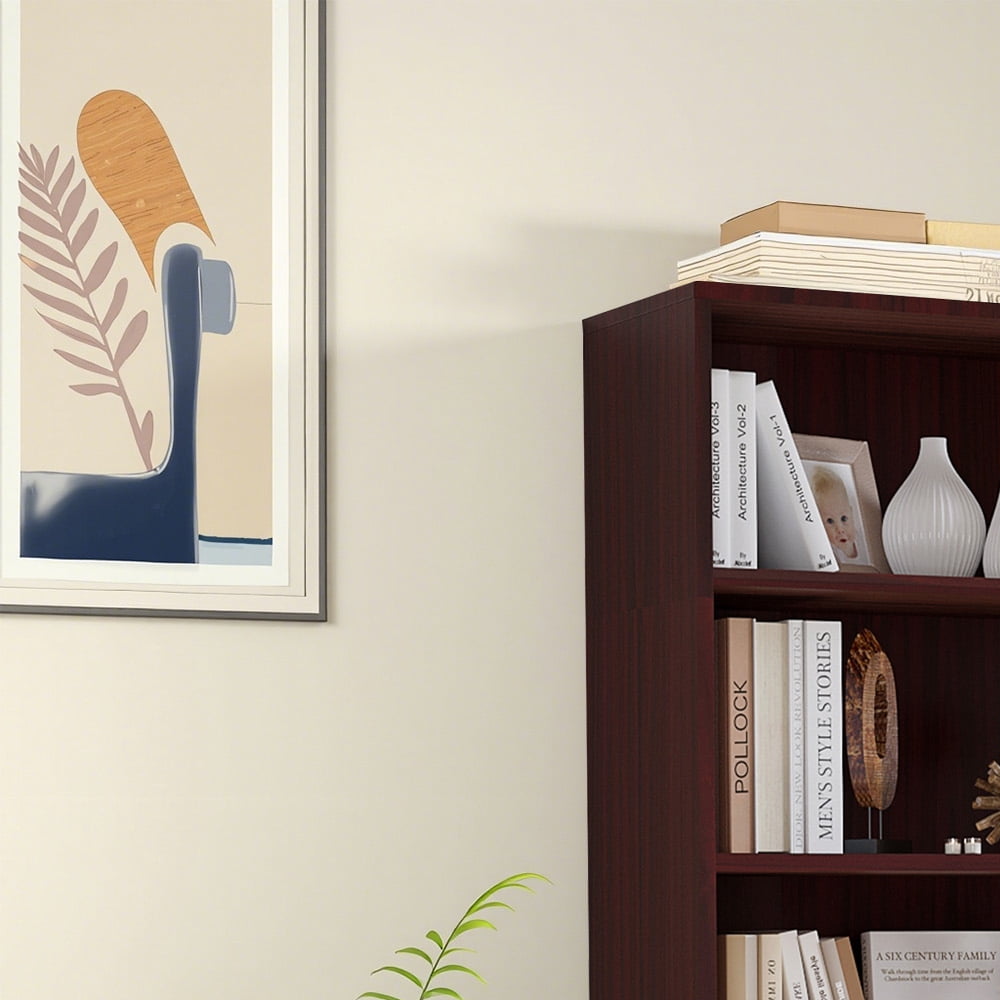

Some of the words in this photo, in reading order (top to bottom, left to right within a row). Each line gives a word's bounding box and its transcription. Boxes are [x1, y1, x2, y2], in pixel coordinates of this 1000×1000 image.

[737, 404, 747, 438] Vol-2
[769, 414, 786, 447] Vol-1
[738, 442, 748, 521] Architecture
[784, 450, 814, 523] Architecture
[816, 631, 832, 712] STORIES
[733, 680, 749, 794] POLLOCK
[817, 717, 832, 778] STYLE
[818, 781, 833, 840] MEN'S
[876, 952, 884, 961] A
[884, 952, 902, 961] SIX
[904, 951, 956, 961] CENTURY
[957, 951, 997, 961] FAMILY
